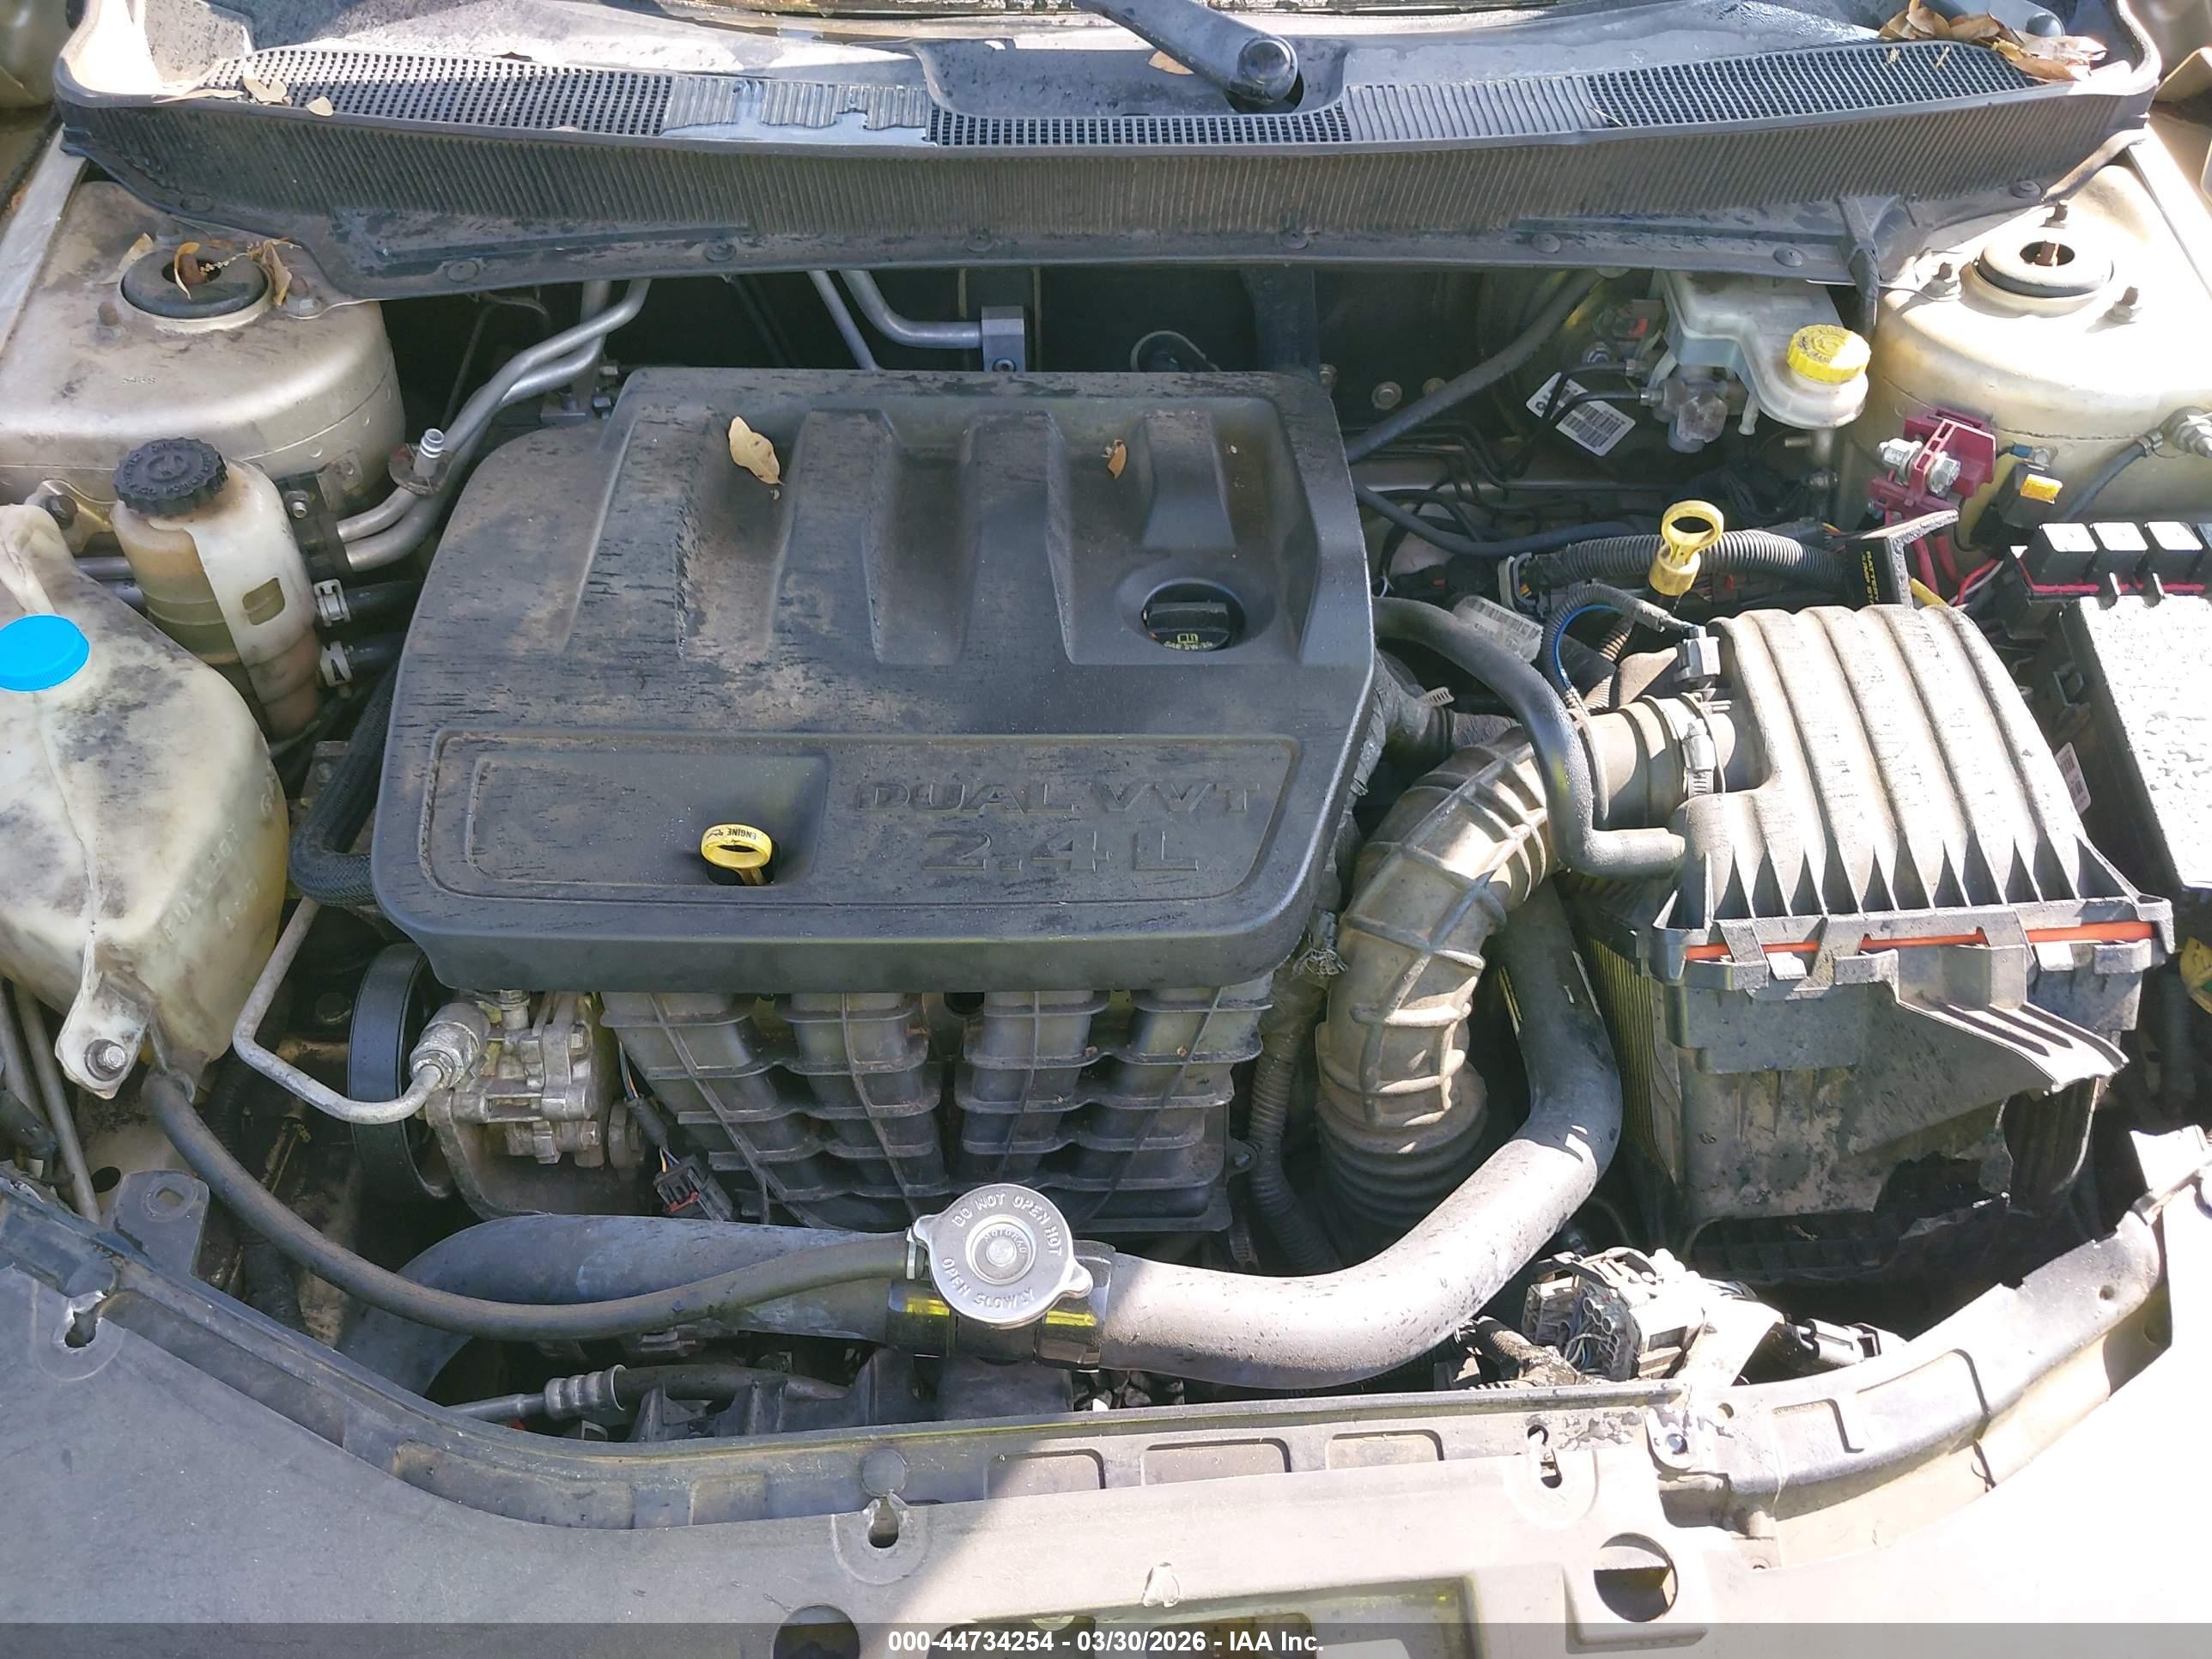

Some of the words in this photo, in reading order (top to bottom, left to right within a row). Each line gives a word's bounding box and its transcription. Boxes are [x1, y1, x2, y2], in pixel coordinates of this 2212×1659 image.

[1866, 550, 1880, 602] BATTERY
[855, 781, 1075, 814] DUAL
[1099, 781, 1261, 814] VVT
[727, 828, 757, 840] ENGINE
[952, 1208, 972, 1227] DO
[975, 1193, 1006, 1212] NOT
[1012, 1194, 1050, 1224] OPEN
[1044, 1224, 1063, 1257] HOT
[943, 1258, 970, 1296] OPEN
[975, 1288, 1034, 1310] SLOWLY
